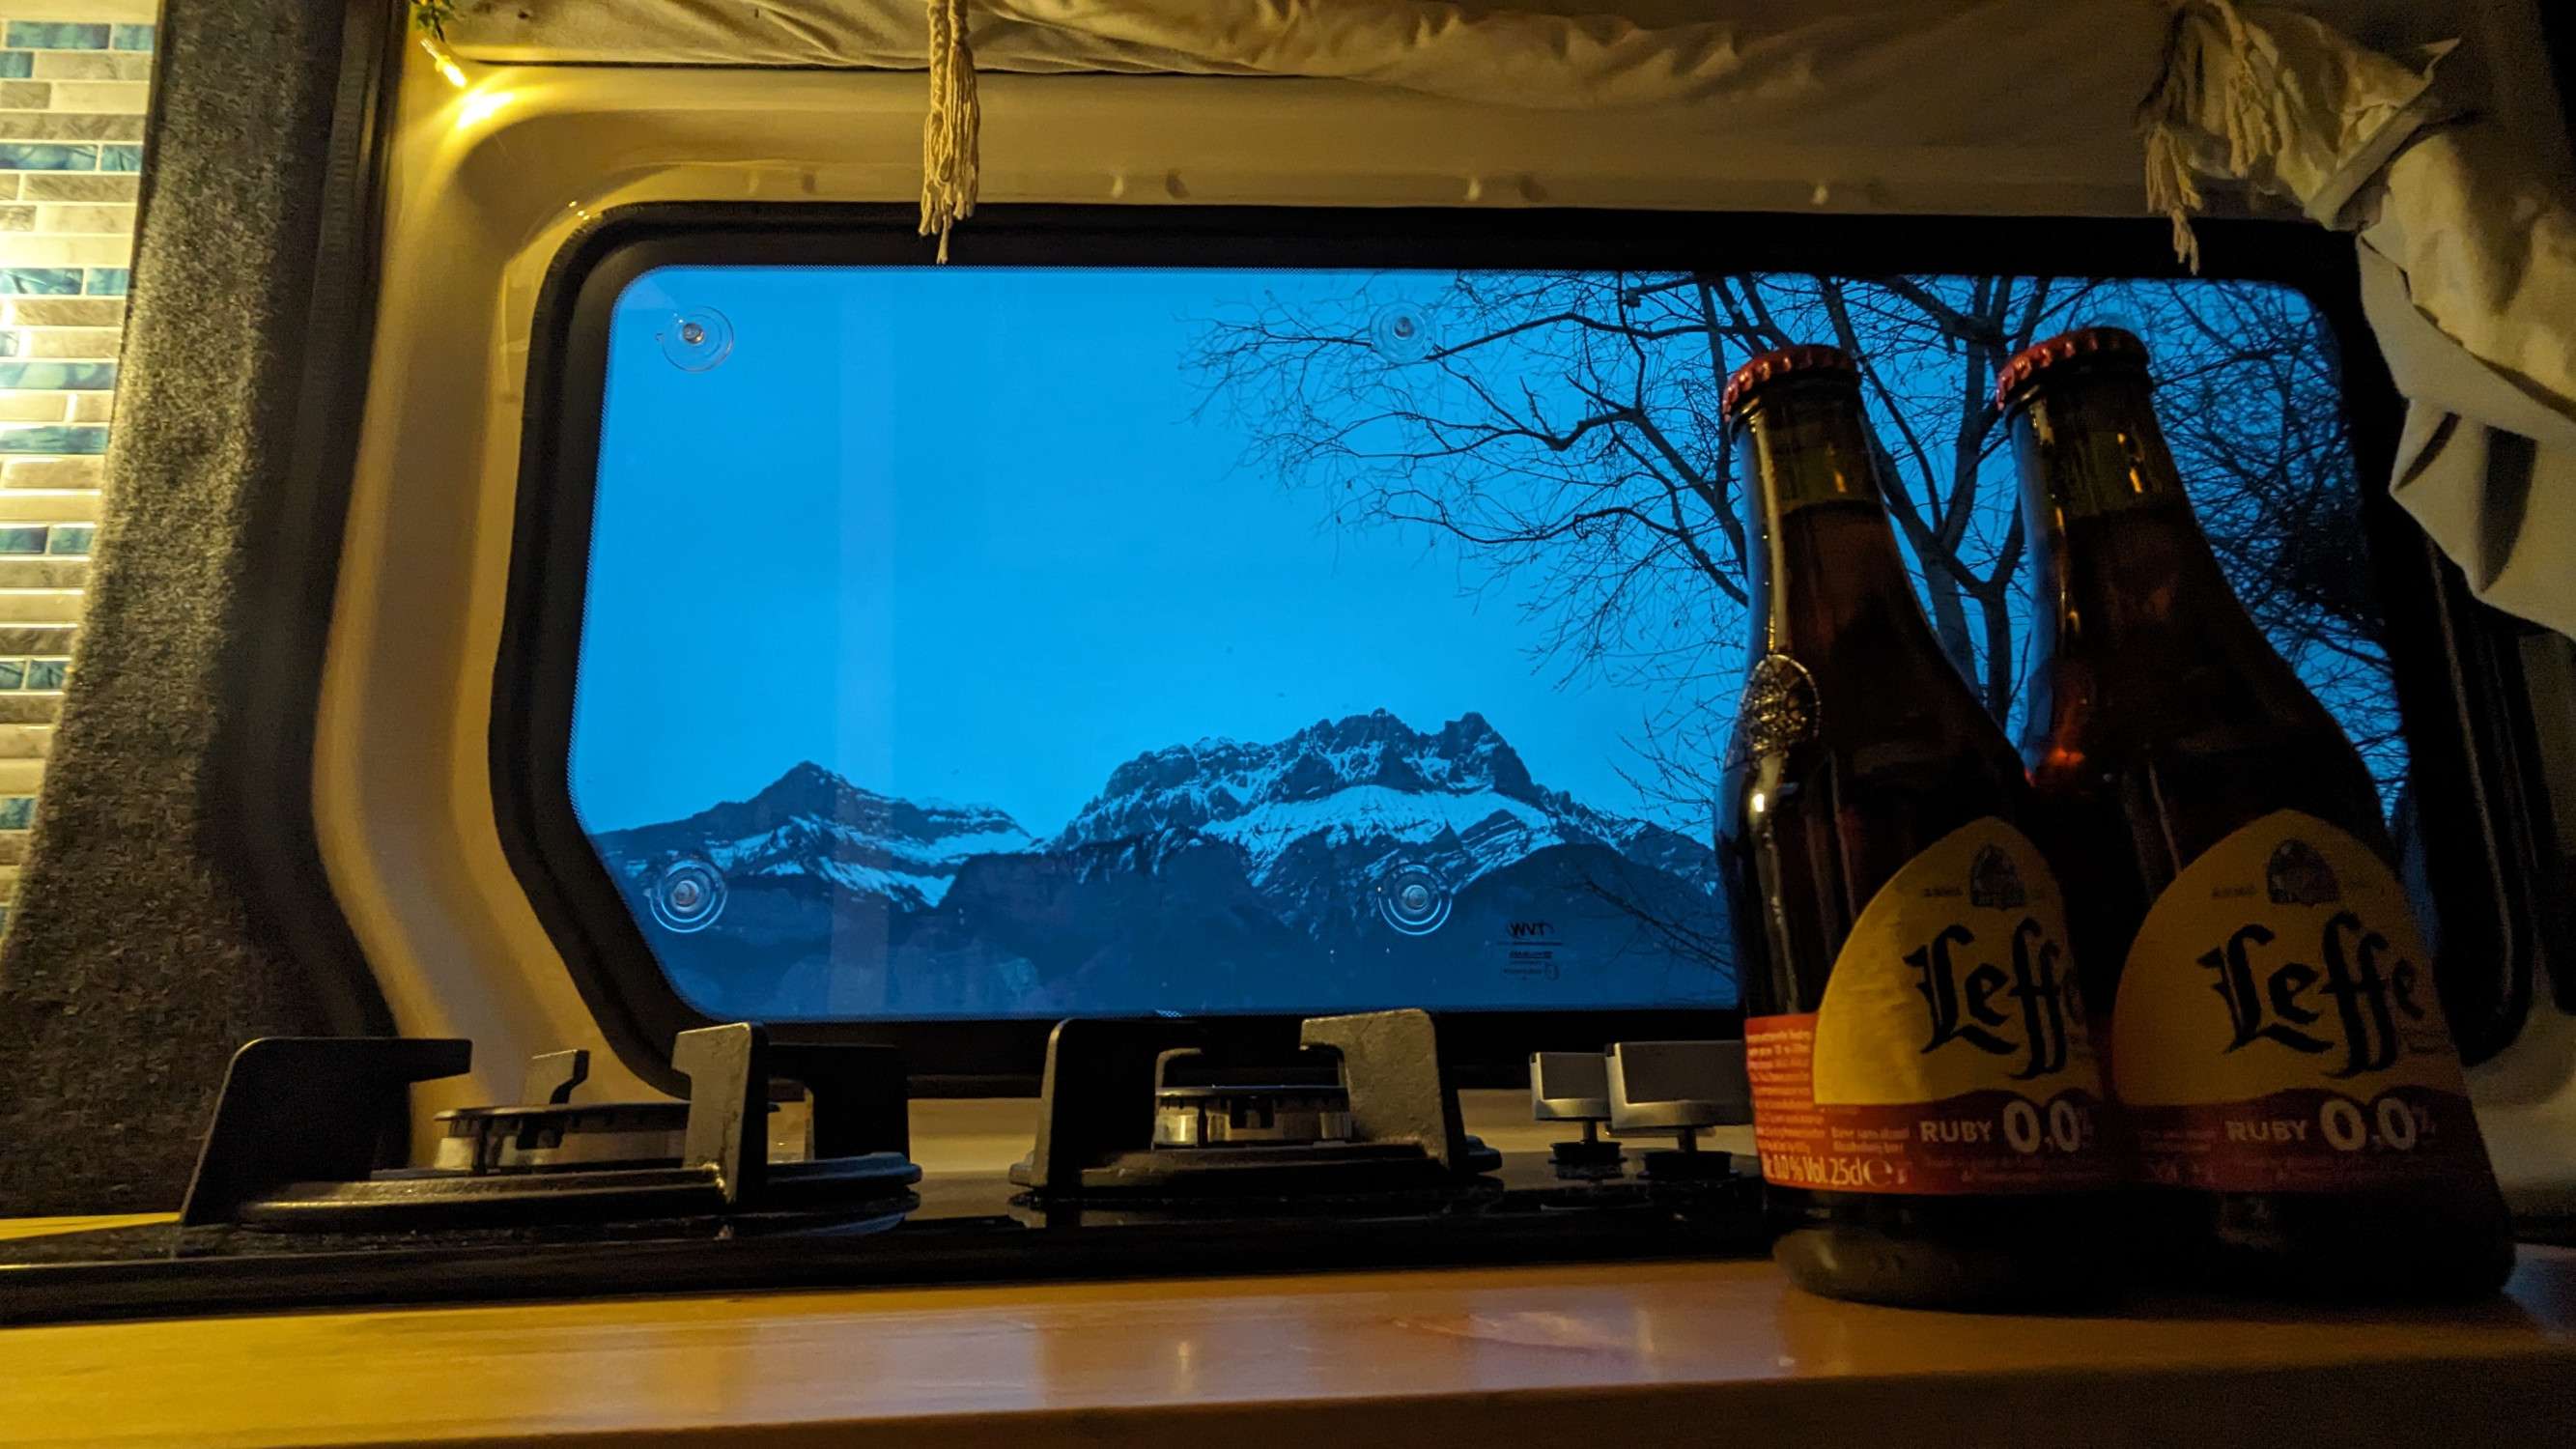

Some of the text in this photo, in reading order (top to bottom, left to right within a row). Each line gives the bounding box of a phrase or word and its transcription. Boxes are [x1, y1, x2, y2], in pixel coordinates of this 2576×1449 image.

[2197, 911, 2423, 1078] Leffe
[1919, 1119, 1993, 1144] RUBY
[2224, 1119, 2309, 1142] RUBY
